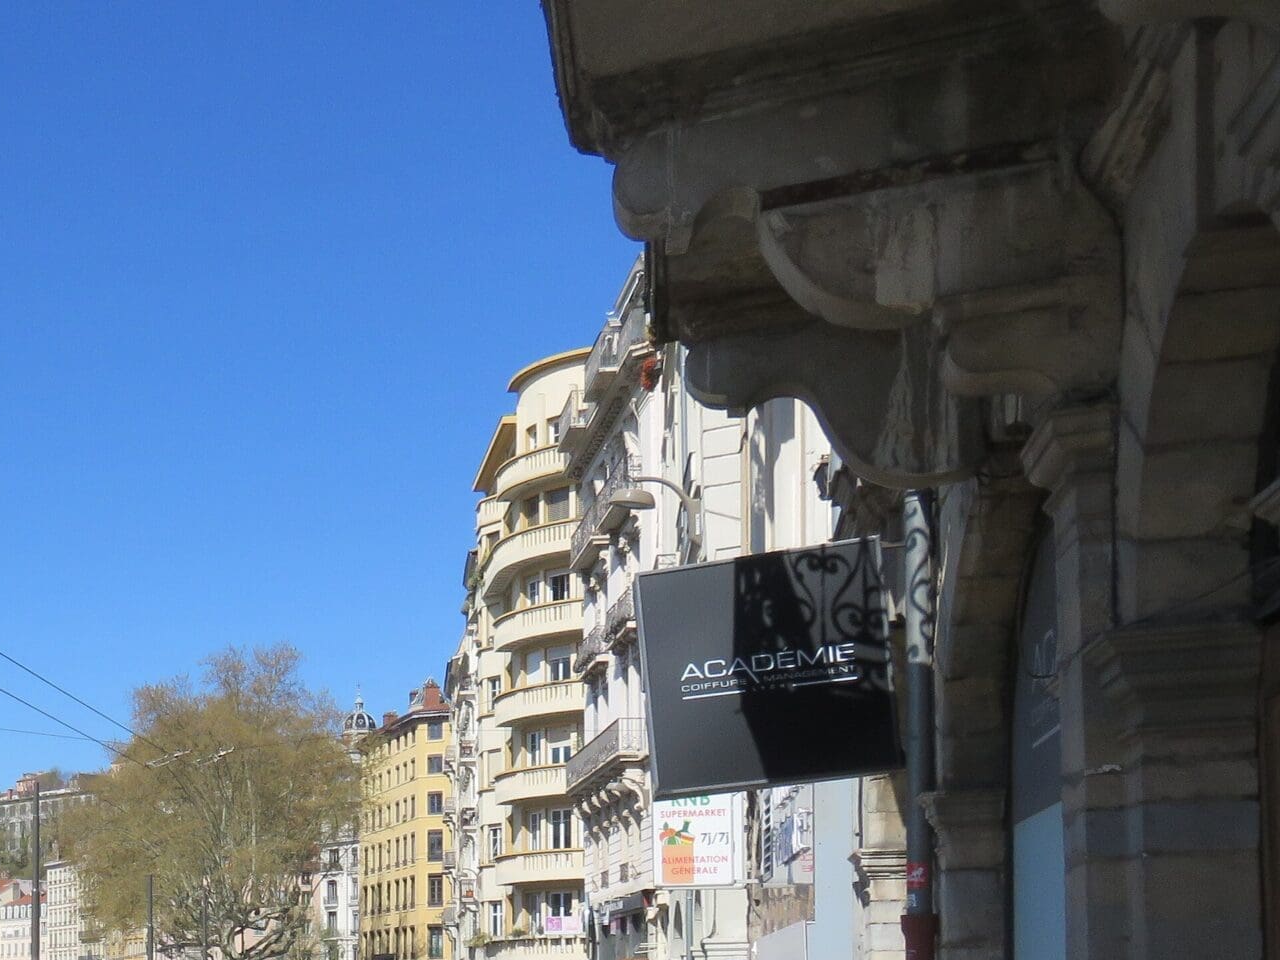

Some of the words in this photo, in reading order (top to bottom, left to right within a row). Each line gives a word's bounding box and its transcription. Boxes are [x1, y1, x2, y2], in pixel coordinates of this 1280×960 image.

[680, 643, 856, 683] ACADÉMIE
[681, 678, 747, 692] COIFFURE
[763, 664, 855, 683] MANAGEMENT
[660, 808, 726, 818] SUPERMARKET
[700, 832, 729, 846] 7j/7j
[662, 855, 728, 865] ALIMENTATION
